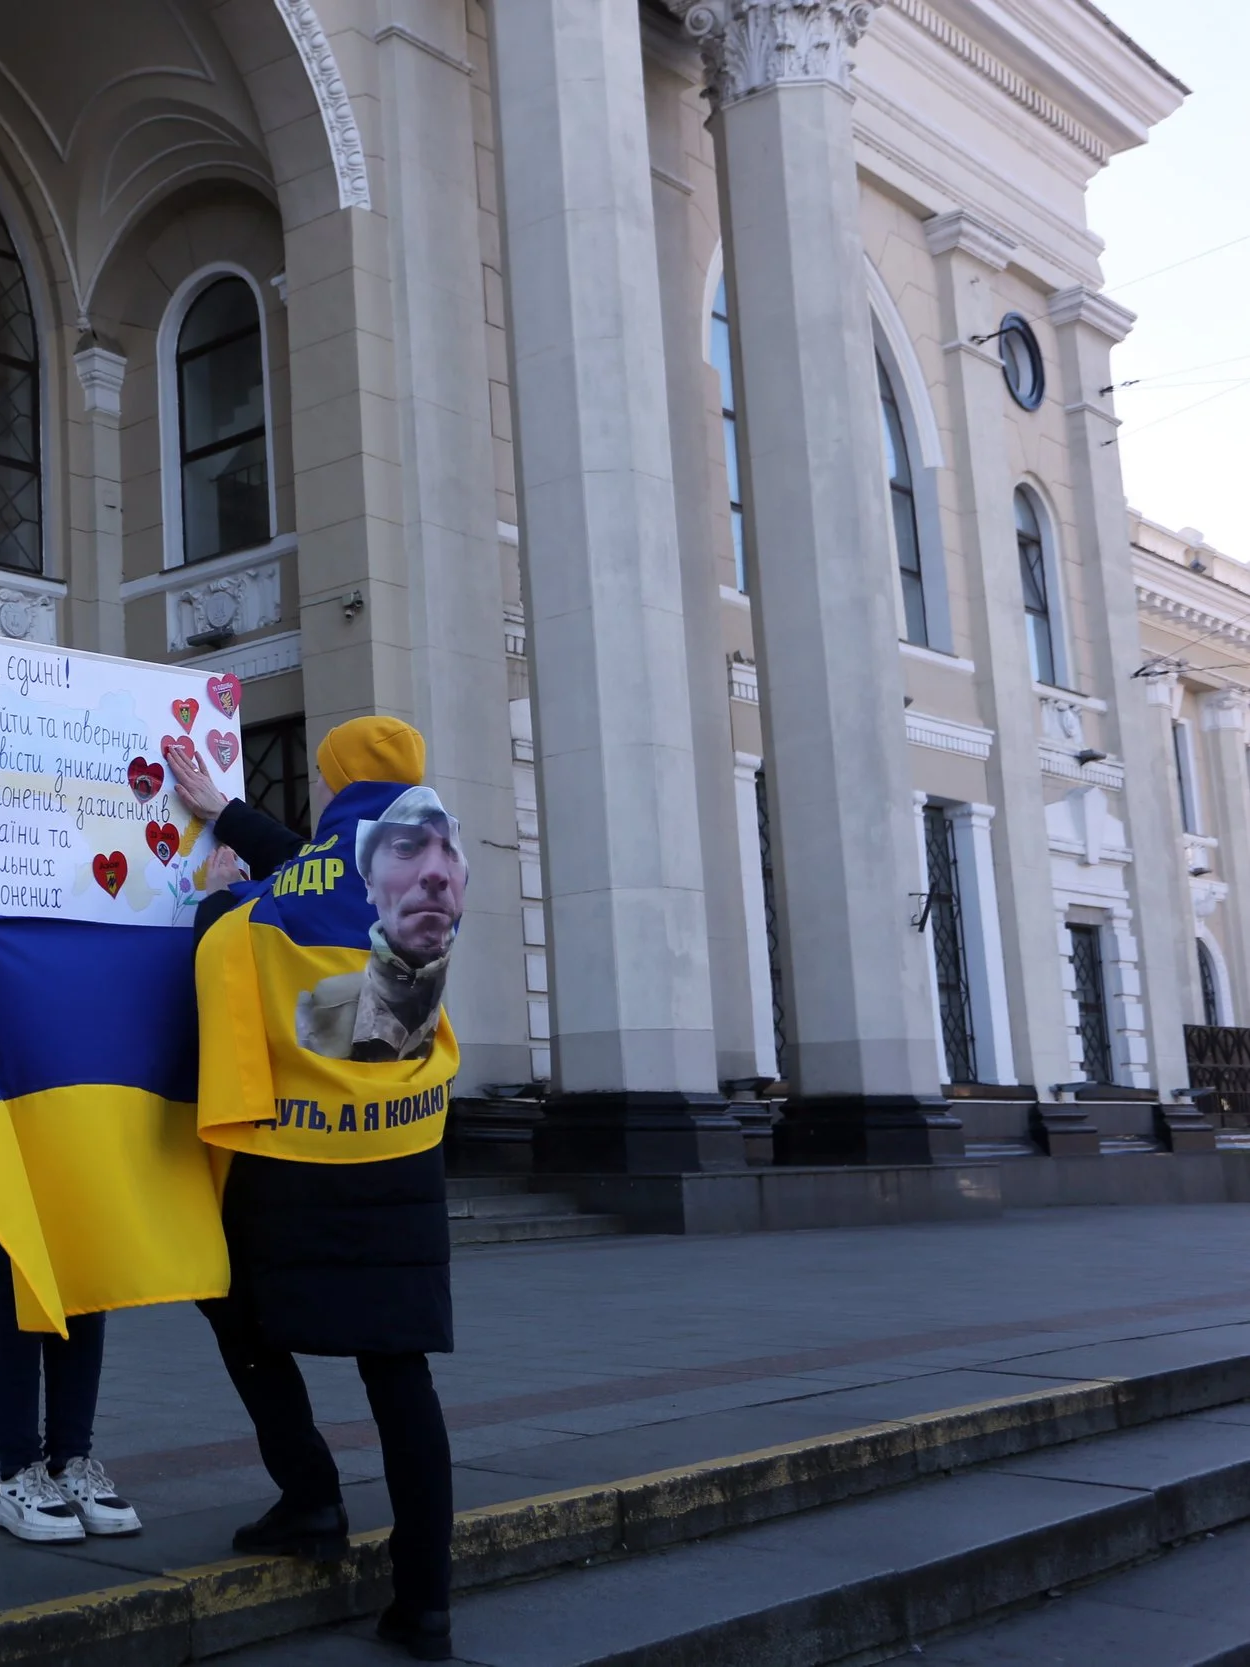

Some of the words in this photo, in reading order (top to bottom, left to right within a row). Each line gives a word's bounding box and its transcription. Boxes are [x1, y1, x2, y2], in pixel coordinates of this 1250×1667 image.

[37, 716, 58, 739] та
[62, 709, 149, 762] повернути
[76, 794, 171, 830] захисників
[48, 828, 72, 849] та
[338, 1104, 357, 1132] А
[364, 1102, 380, 1132] Я
[386, 1084, 444, 1129] КОХАЮ
